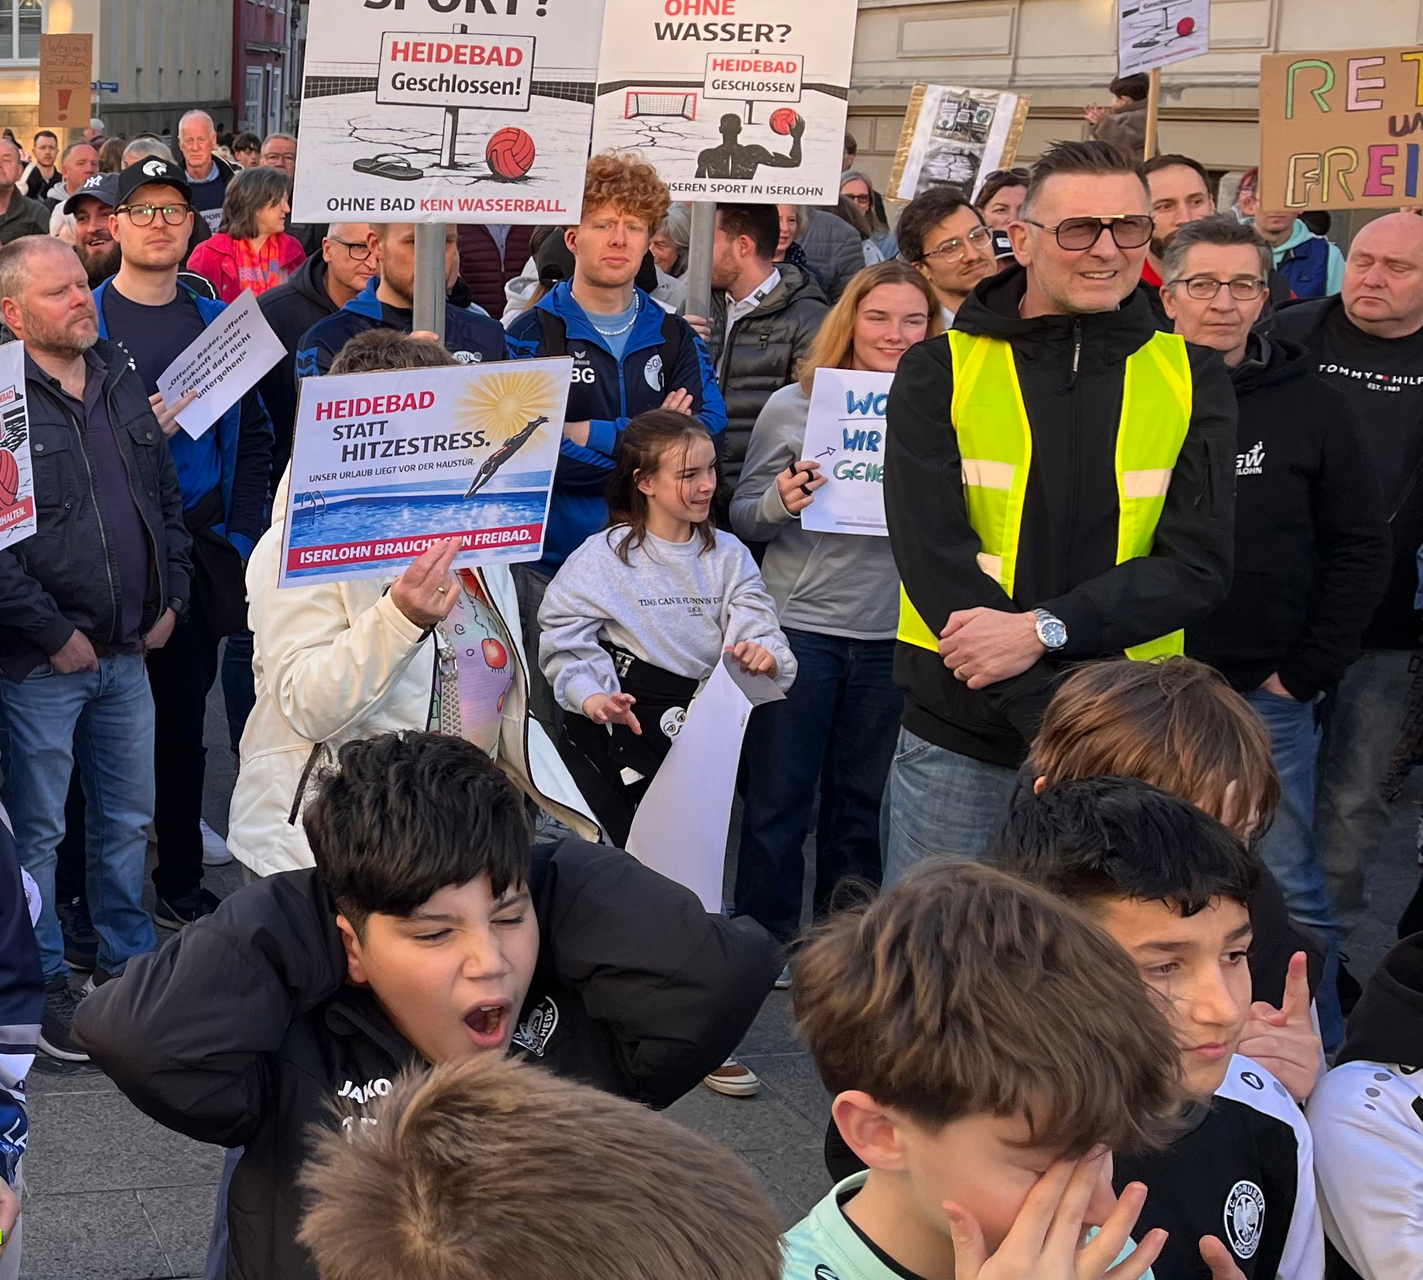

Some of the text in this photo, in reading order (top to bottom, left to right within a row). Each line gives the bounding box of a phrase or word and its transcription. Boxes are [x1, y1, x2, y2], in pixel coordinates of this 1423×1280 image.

[654, 22, 792, 43] WASSER?
[390, 41, 523, 67] HEIDEBAD
[712, 58, 797, 74] HEIDEBAD
[391, 72, 521, 96] Geschlossen!
[712, 79, 795, 93] GESCHLOSSEN
[666, 182, 824, 196] NSEREN SPORT IN ISERLOHN
[327, 197, 567, 213] OHNE BAD KEIN WASSERBALL.
[1319, 364, 1373, 379] TOMMY
[316, 390, 435, 421] HEIDEBAD
[332, 420, 388, 441] STATT
[842, 427, 882, 452] WIR
[341, 430, 491, 462] HITZESTRESS.
[309, 457, 476, 483] UNSER URLAUB LIEGT VOR DER HAUSTÜR.
[299, 545, 371, 564] ISERLOHN
[474, 529, 532, 546] FREIBAD.
[658, 597, 675, 606] CAN
[338, 1077, 393, 1105] JAKO
